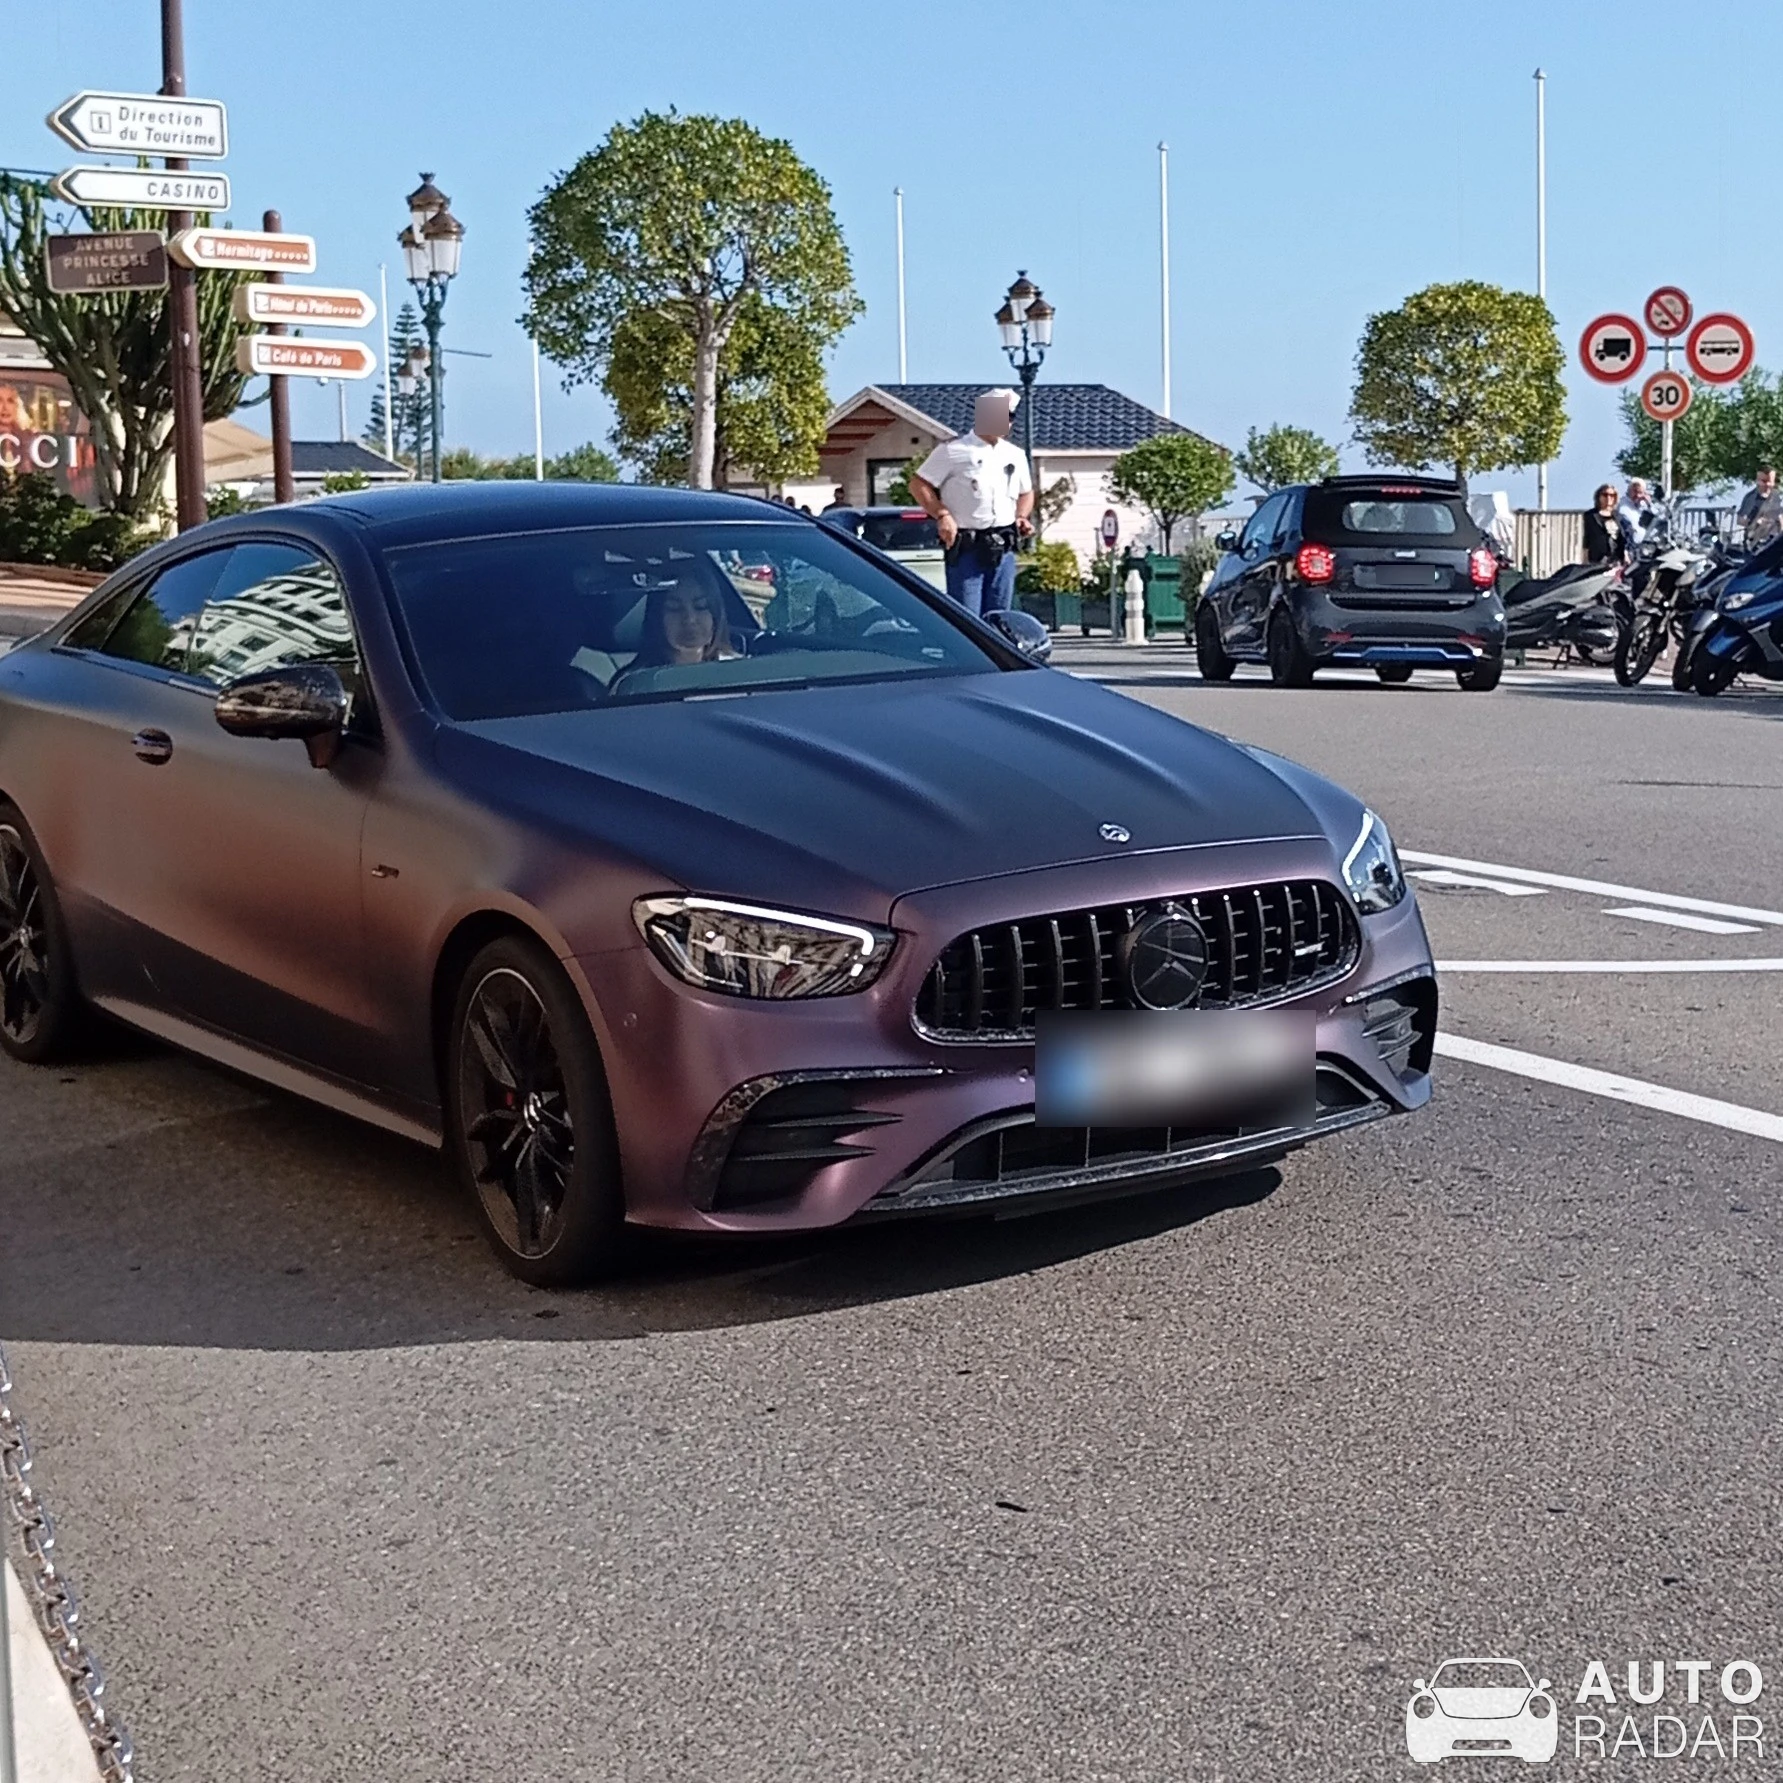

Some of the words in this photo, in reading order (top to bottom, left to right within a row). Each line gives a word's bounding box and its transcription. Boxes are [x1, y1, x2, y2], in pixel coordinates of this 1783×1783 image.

[119, 106, 203, 127] Direction
[119, 126, 138, 141] du
[145, 127, 216, 146] Tourisme
[147, 182, 219, 200] CASINO
[75, 237, 134, 252] AVENUE
[63, 253, 150, 269] PRINCESSE
[86, 271, 131, 286] ALICE
[315, 351, 342, 367] Paris
[1652, 386, 1679, 406] 30
